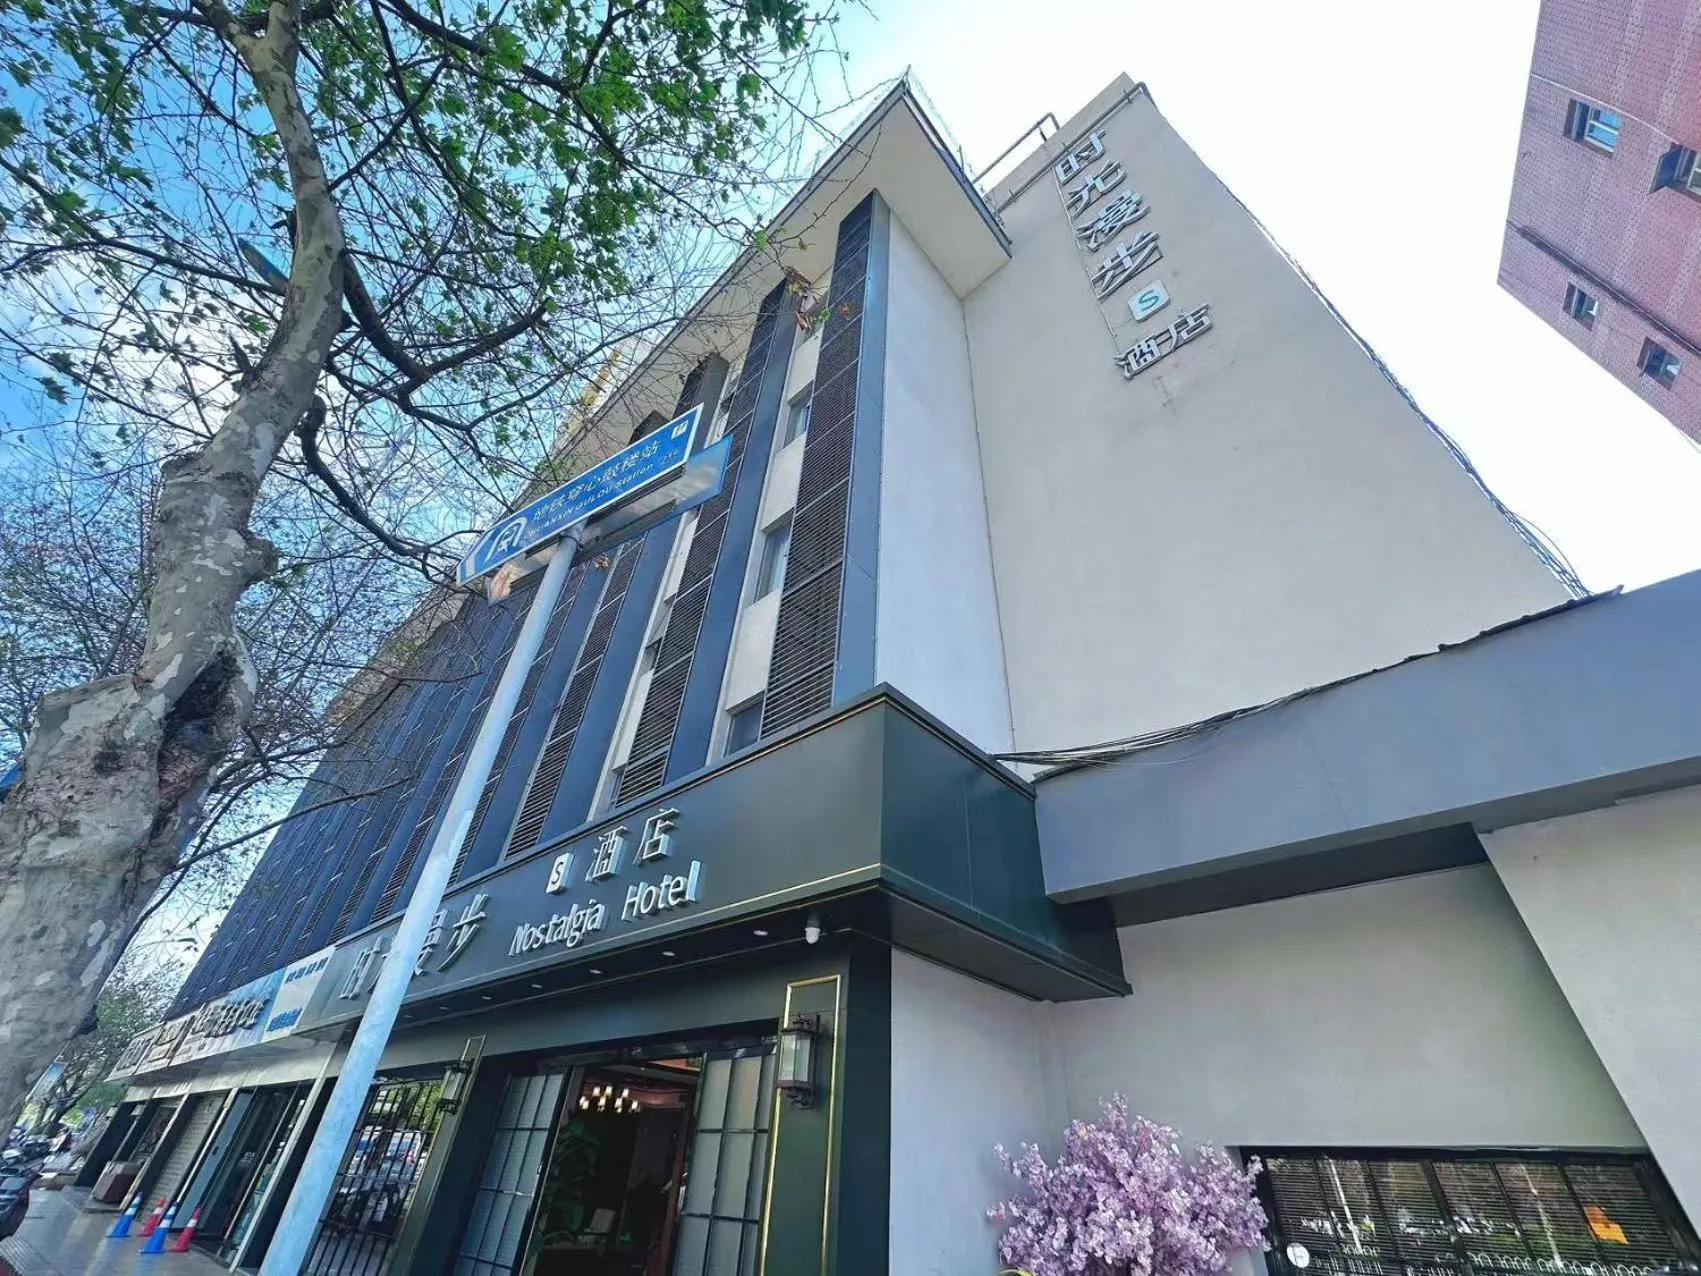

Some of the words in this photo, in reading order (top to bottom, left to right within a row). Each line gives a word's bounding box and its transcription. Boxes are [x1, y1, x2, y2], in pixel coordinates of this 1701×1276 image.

[1054, 129, 1160, 300] 时光漫步
[1114, 302, 1212, 380] 酒店
[585, 808, 680, 882] 酒店
[508, 899, 605, 957] Nostalgia
[621, 861, 701, 921] Hotel
